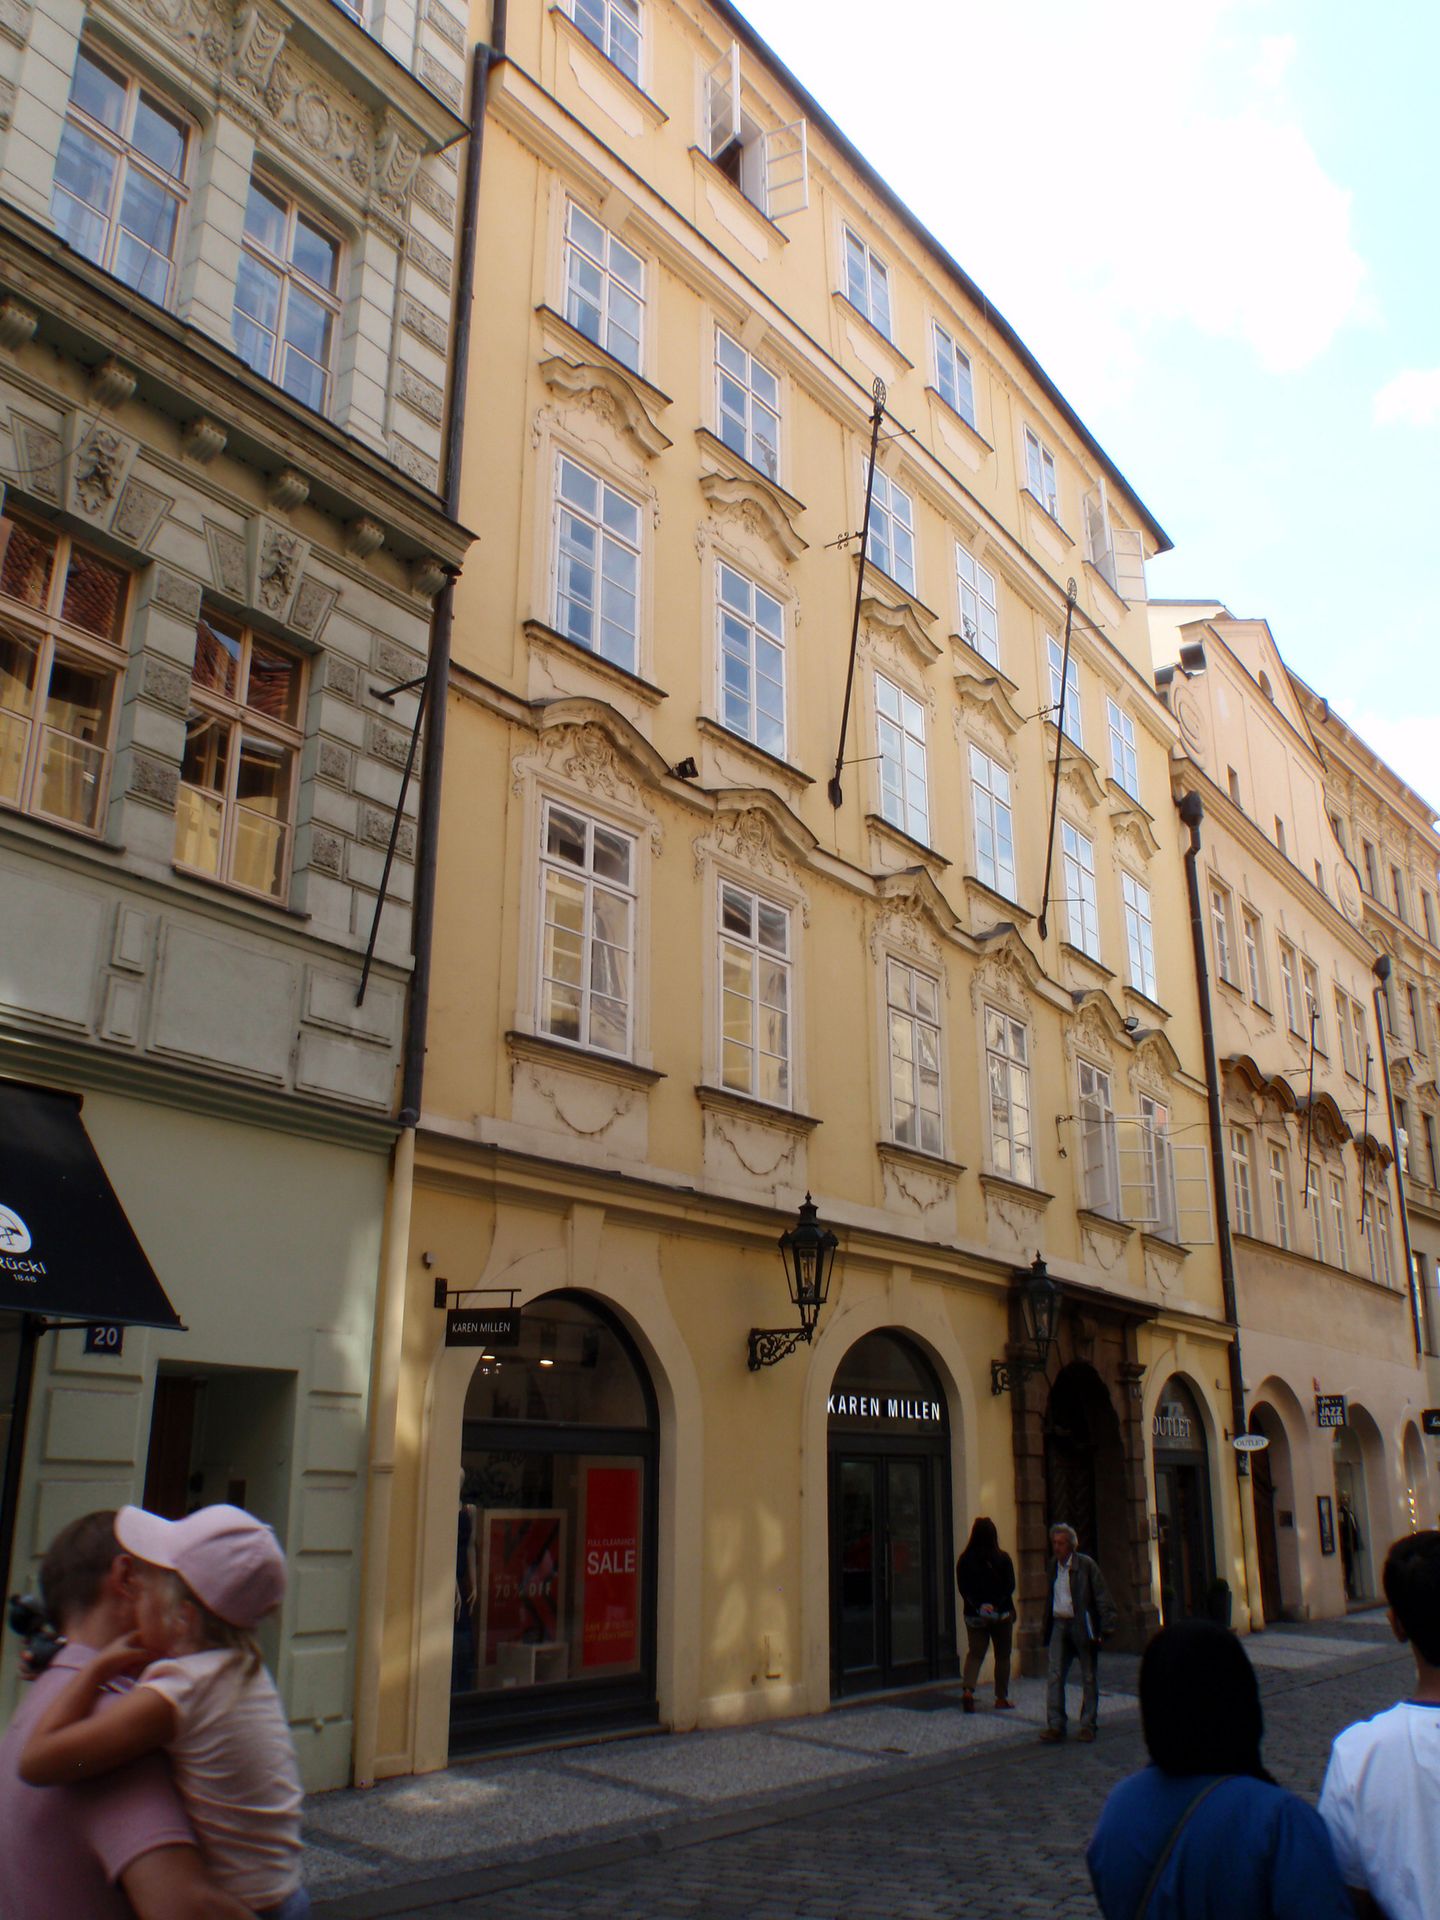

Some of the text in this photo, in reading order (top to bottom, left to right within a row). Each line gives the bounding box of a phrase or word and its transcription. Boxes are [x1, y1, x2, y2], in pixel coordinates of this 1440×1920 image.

[452, 1321, 511, 1333] KAREN MILLEN
[93, 1327, 118, 1346] 20
[827, 1393, 940, 1421] KAREN MILLEN
[1319, 1406, 1343, 1416] JAZZ
[1152, 1415, 1192, 1438] OUTLET
[1320, 1416, 1344, 1426] CLUB
[1236, 1439, 1265, 1447] OUTLET
[587, 1550, 636, 1575] SALE
